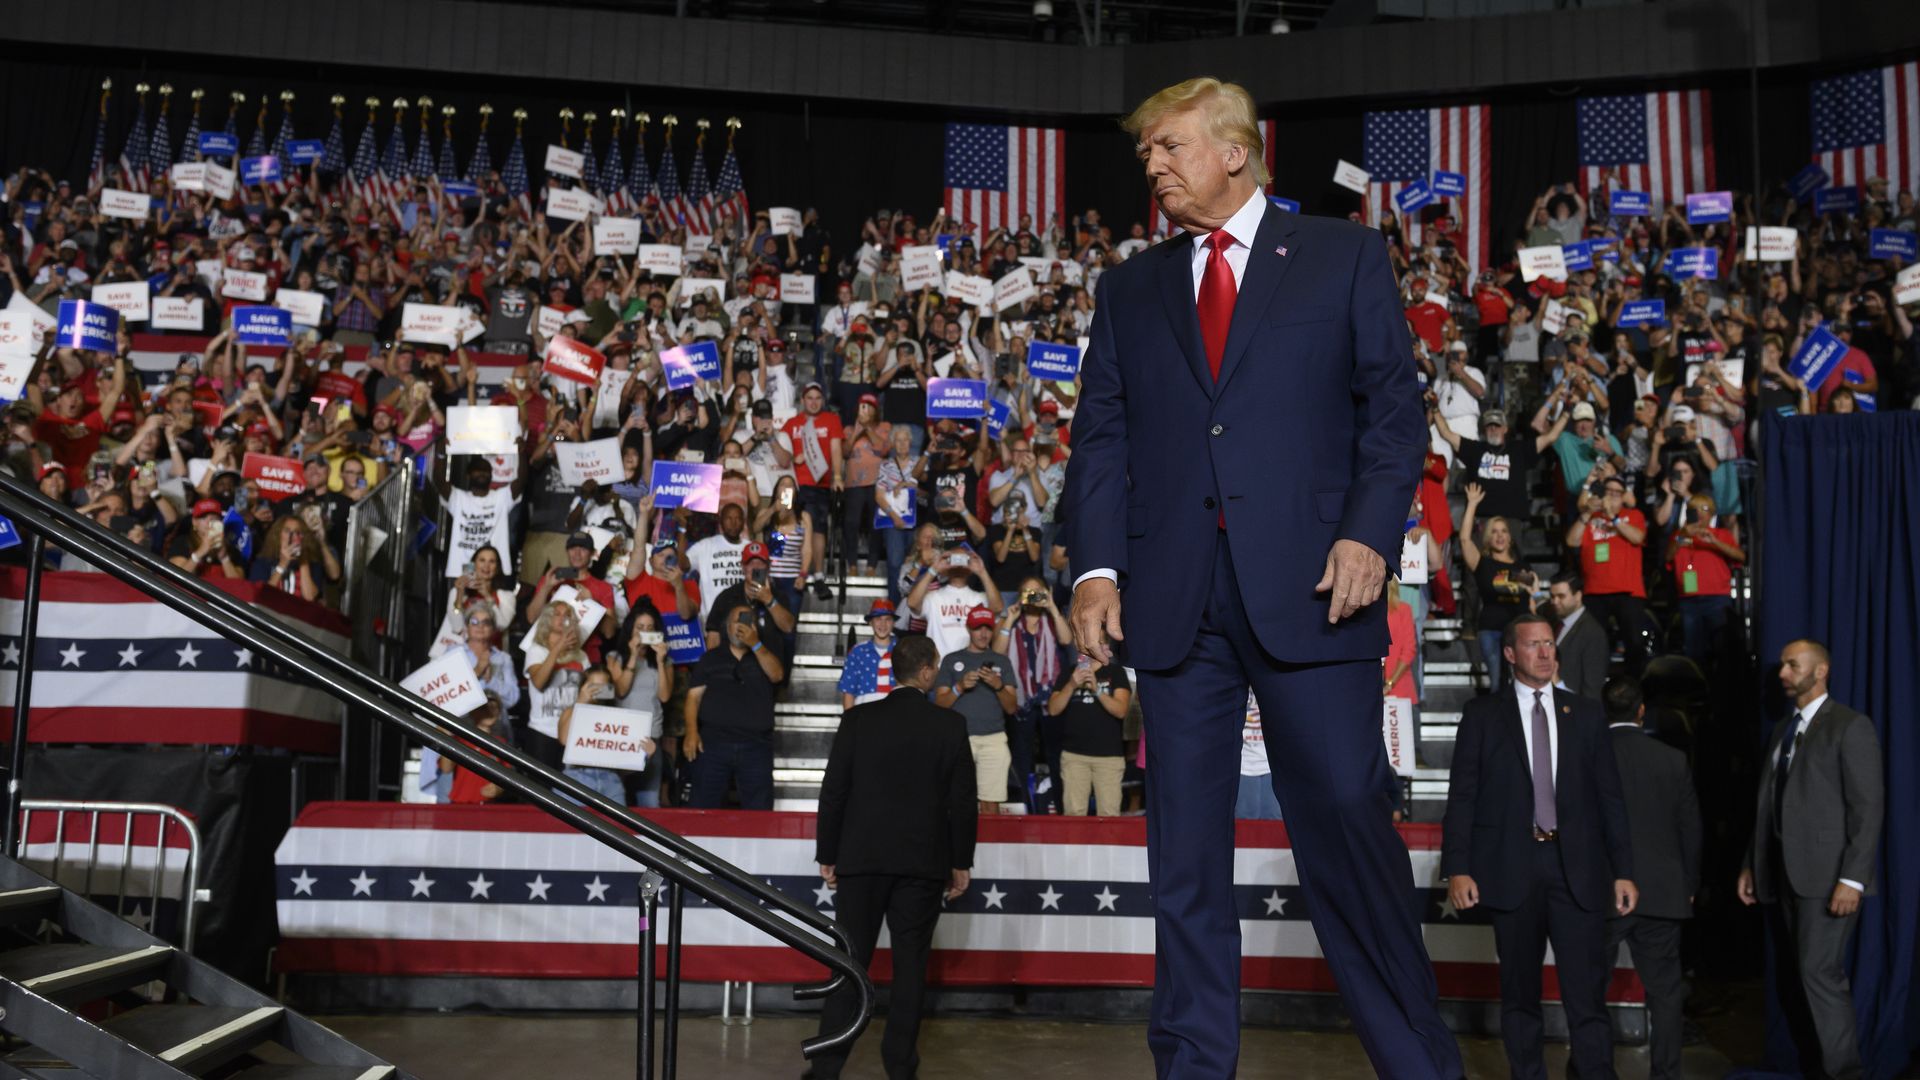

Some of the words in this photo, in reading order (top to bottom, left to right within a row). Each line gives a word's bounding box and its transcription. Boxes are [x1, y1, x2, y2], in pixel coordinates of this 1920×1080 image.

[85, 313, 107, 327] AVE
[250, 314, 278, 324] SAVE
[1043, 352, 1067, 362] SAVE
[1032, 361, 1075, 373] AMERICA!
[944, 389, 972, 398] SAVE
[932, 399, 982, 408] AMERICA!
[262, 466, 294, 480] SAVE
[671, 473, 702, 484] SAVE
[257, 480, 303, 494] MERICA!
[712, 561, 741, 570] BLAC
[941, 604, 971, 616] VANC
[667, 624, 690, 636] SAVE
[669, 638, 702, 649] MERICA!
[420, 672, 450, 697] SAVE
[594, 723, 630, 736] SAVE
[1389, 705, 1400, 766] AMERICA!
[576, 737, 640, 754] AMERICA!
